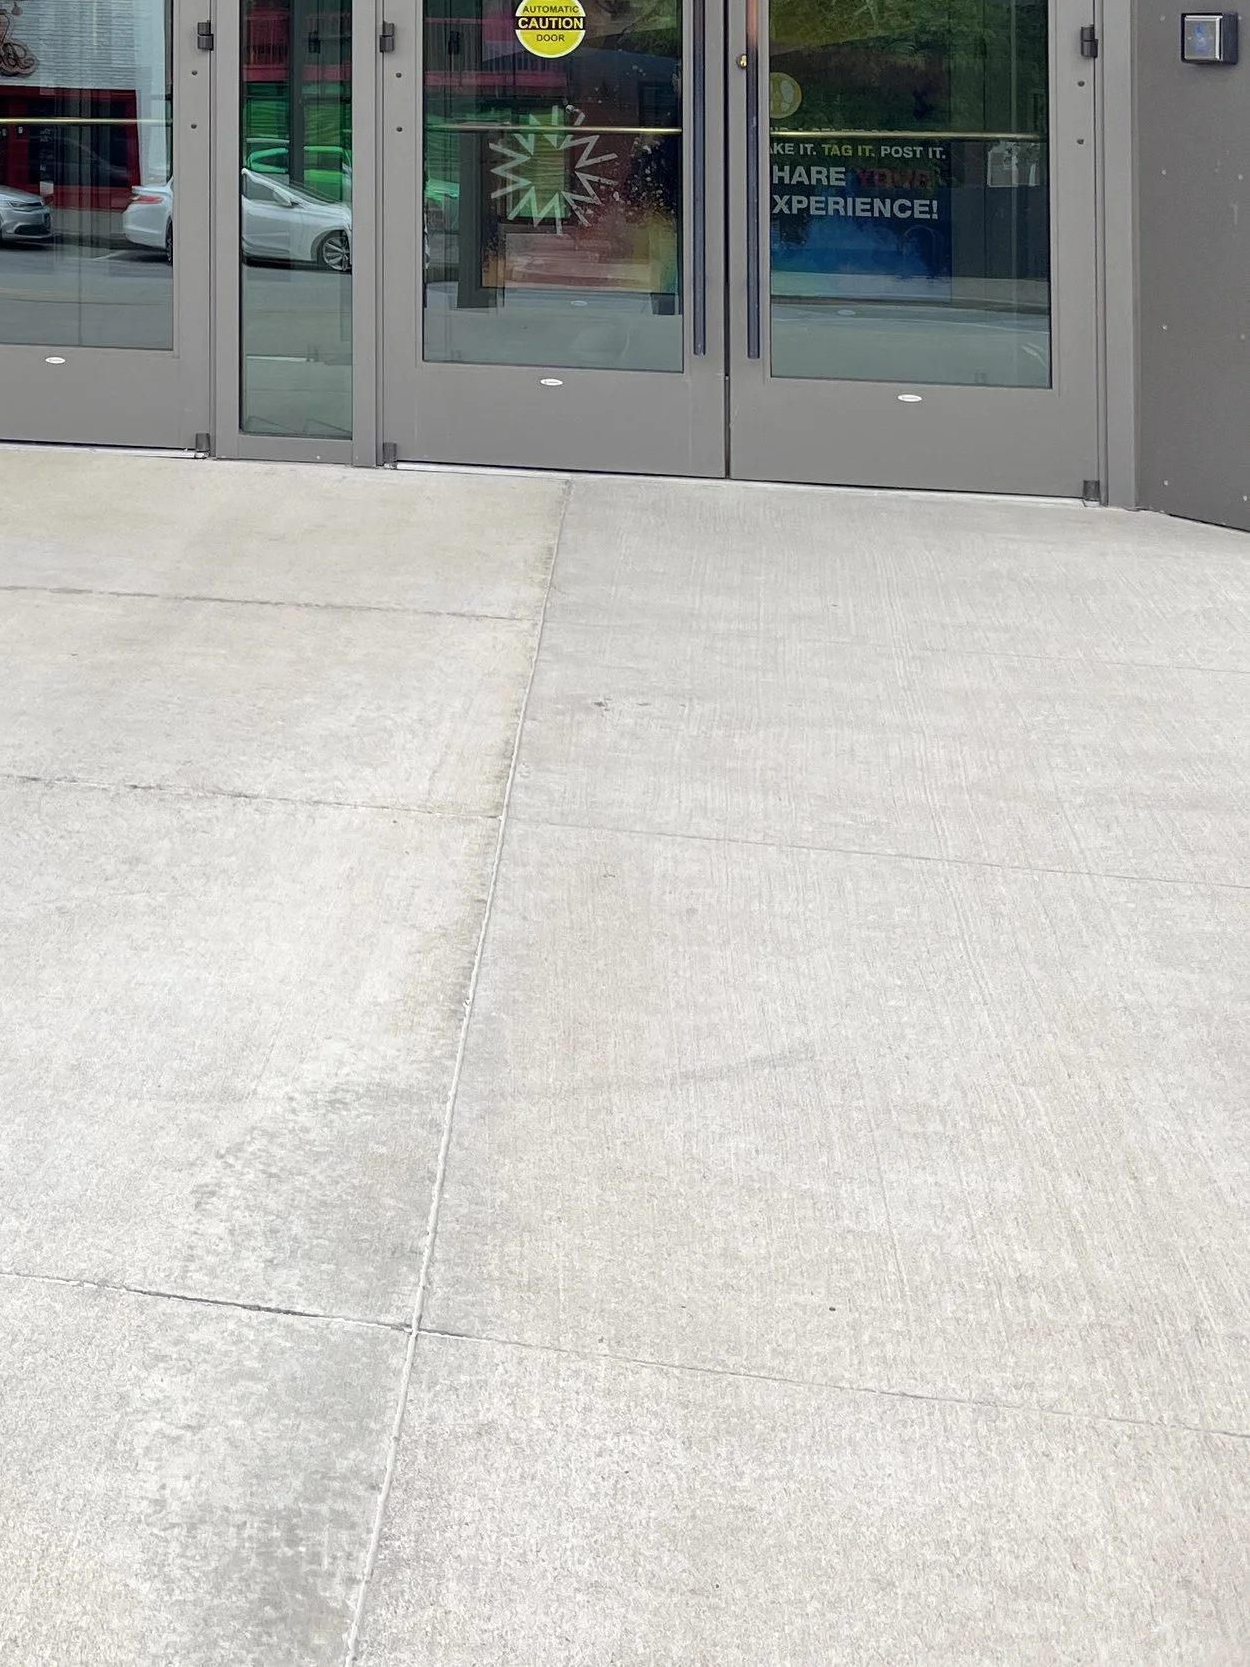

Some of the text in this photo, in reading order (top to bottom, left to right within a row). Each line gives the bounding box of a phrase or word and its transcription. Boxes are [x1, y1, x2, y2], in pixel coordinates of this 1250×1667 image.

[522, 5, 579, 14] AUTOMATIC
[517, 17, 584, 30] CAUTION
[536, 34, 565, 42] DOOR
[799, 143, 817, 155] IT.
[822, 144, 852, 156] TAG
[857, 145, 876, 157] IT.
[880, 146, 923, 159] POST
[928, 147, 946, 159] IT.
[772, 194, 939, 220] XPERIENCE!
